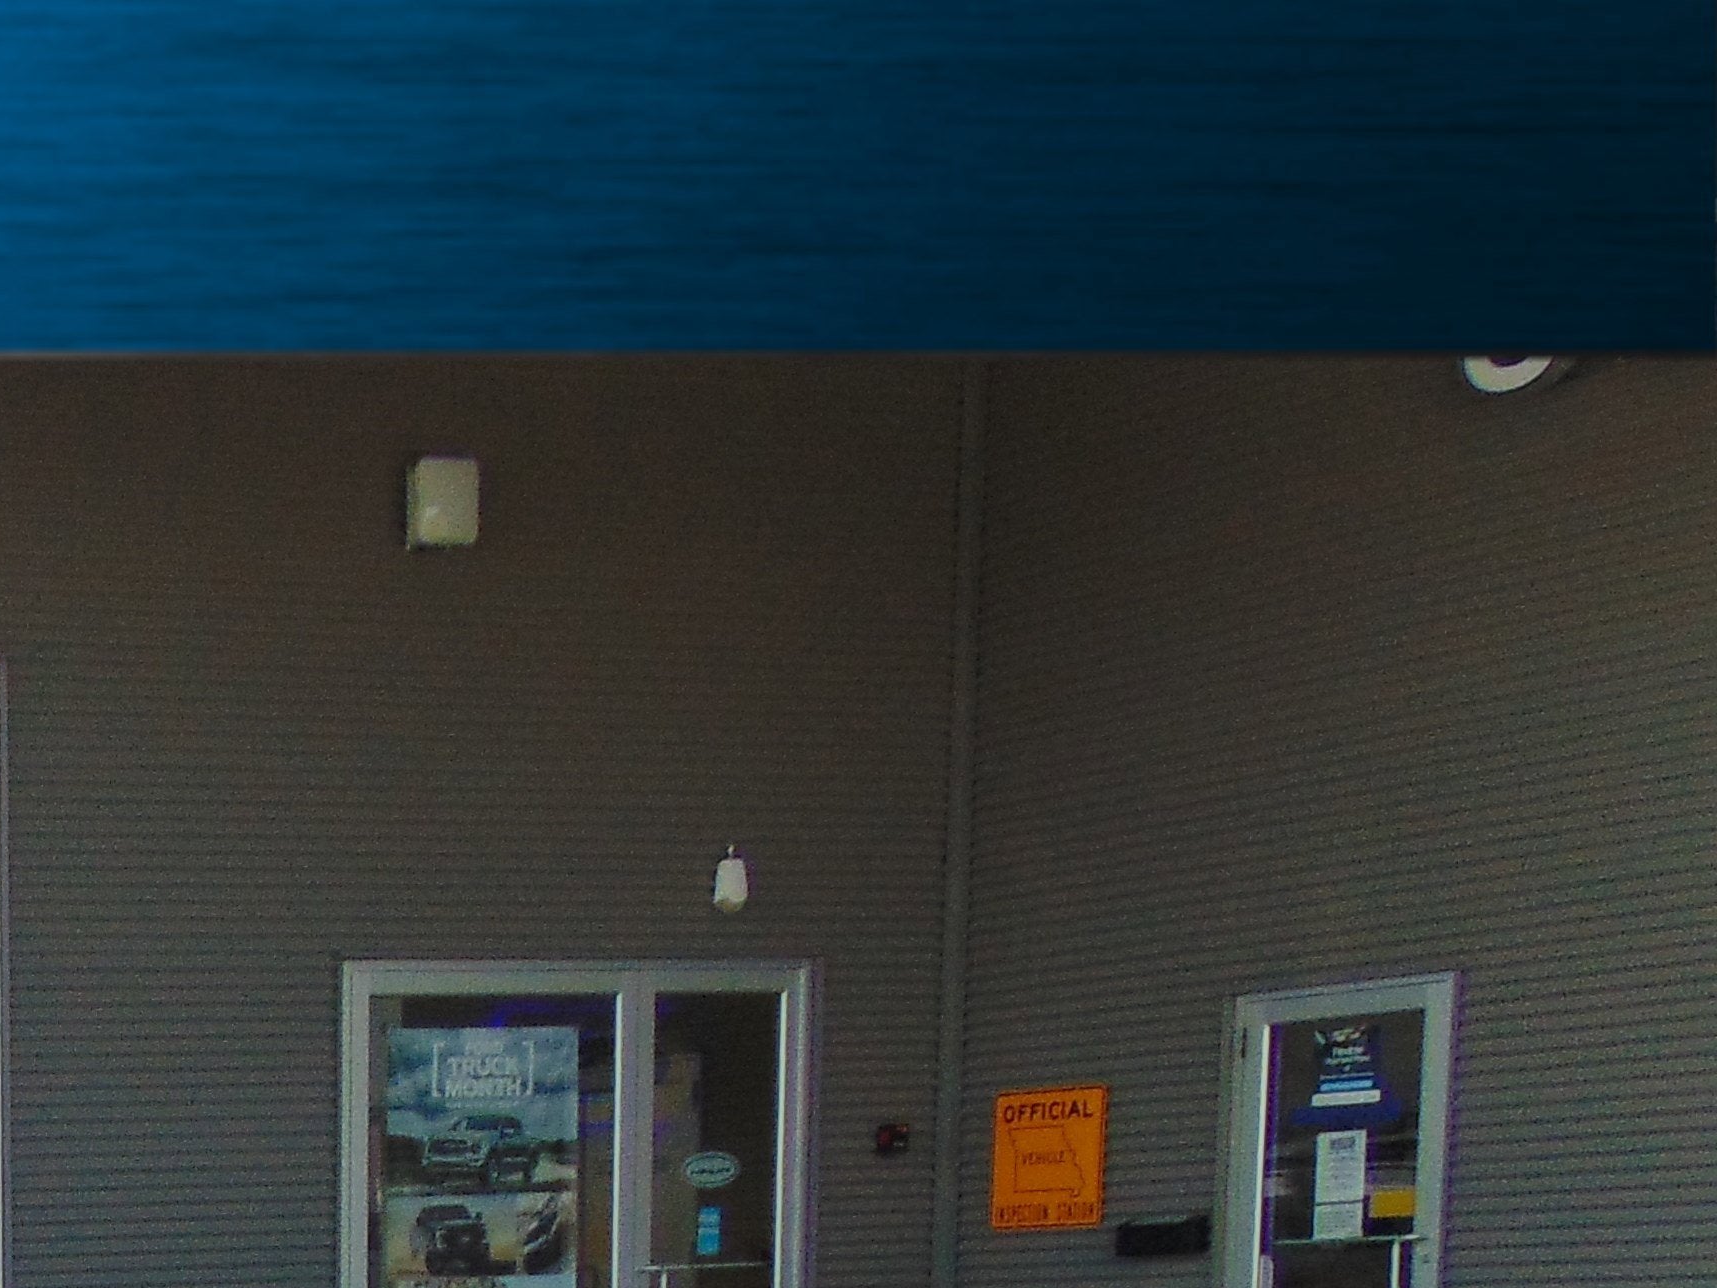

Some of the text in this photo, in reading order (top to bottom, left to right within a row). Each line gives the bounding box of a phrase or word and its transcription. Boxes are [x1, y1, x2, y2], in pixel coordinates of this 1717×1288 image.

[446, 1055, 519, 1076] TRUCK
[444, 1075, 522, 1098] MONTH
[1003, 1098, 1094, 1124] OFFICIAL
[1022, 1150, 1066, 1165] VEHICLE
